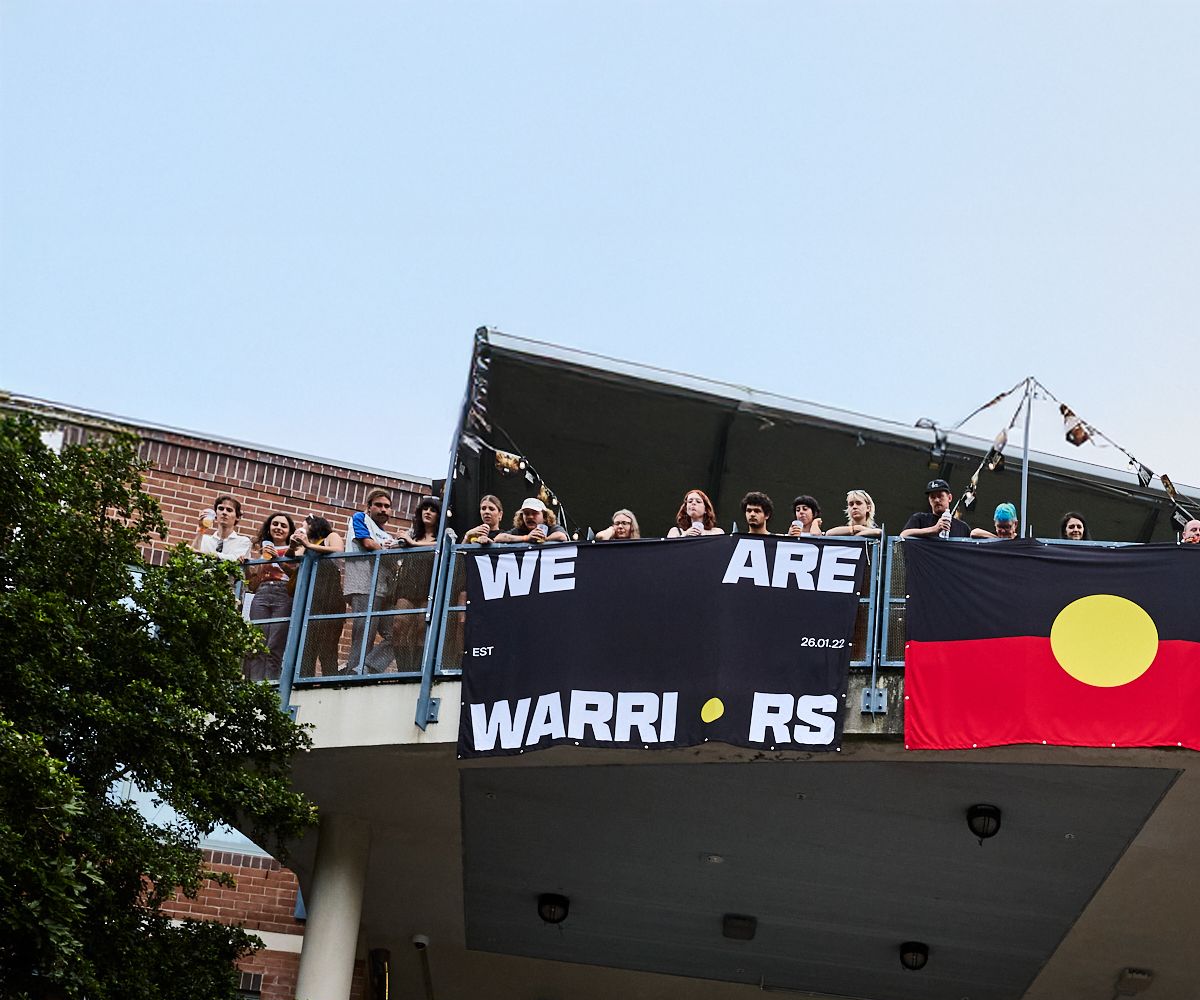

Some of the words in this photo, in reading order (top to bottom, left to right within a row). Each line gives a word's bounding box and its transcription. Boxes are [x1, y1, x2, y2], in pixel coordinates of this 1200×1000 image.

[475, 545, 578, 600] WE
[722, 538, 862, 594] ARE
[800, 637, 845, 649] 26.01.22
[472, 646, 494, 657] EST
